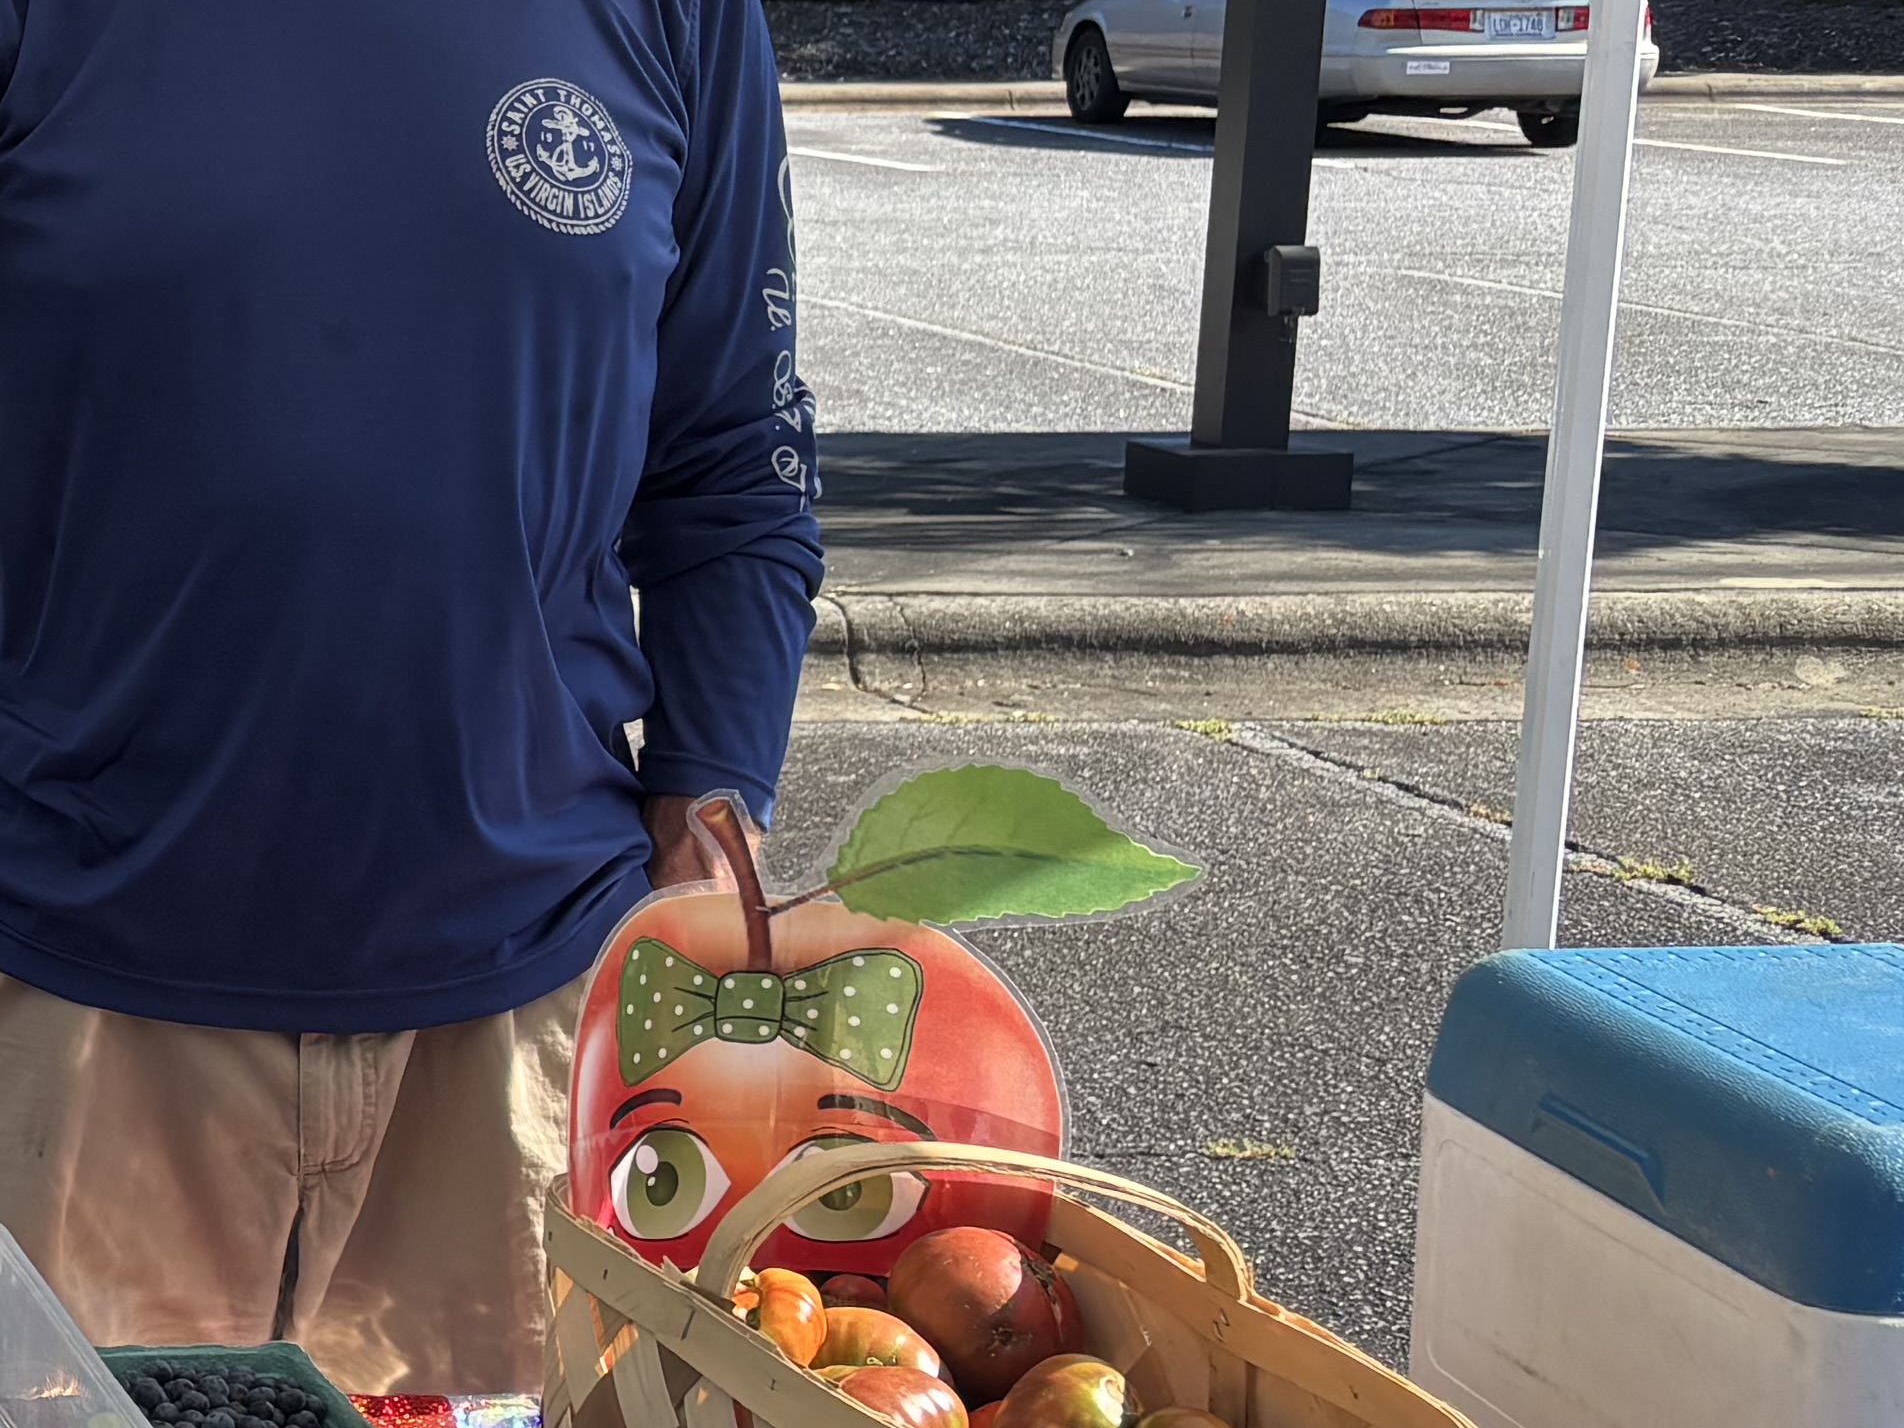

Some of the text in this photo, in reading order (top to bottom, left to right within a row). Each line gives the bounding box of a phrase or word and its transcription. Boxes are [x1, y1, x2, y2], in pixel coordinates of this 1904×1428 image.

[501, 89, 621, 155] SAINT THOMAS
[540, 131, 553, 143] 19
[582, 140, 595, 152] 17
[522, 172, 574, 217] VIRGIN
[578, 172, 622, 219] ISLANDS
